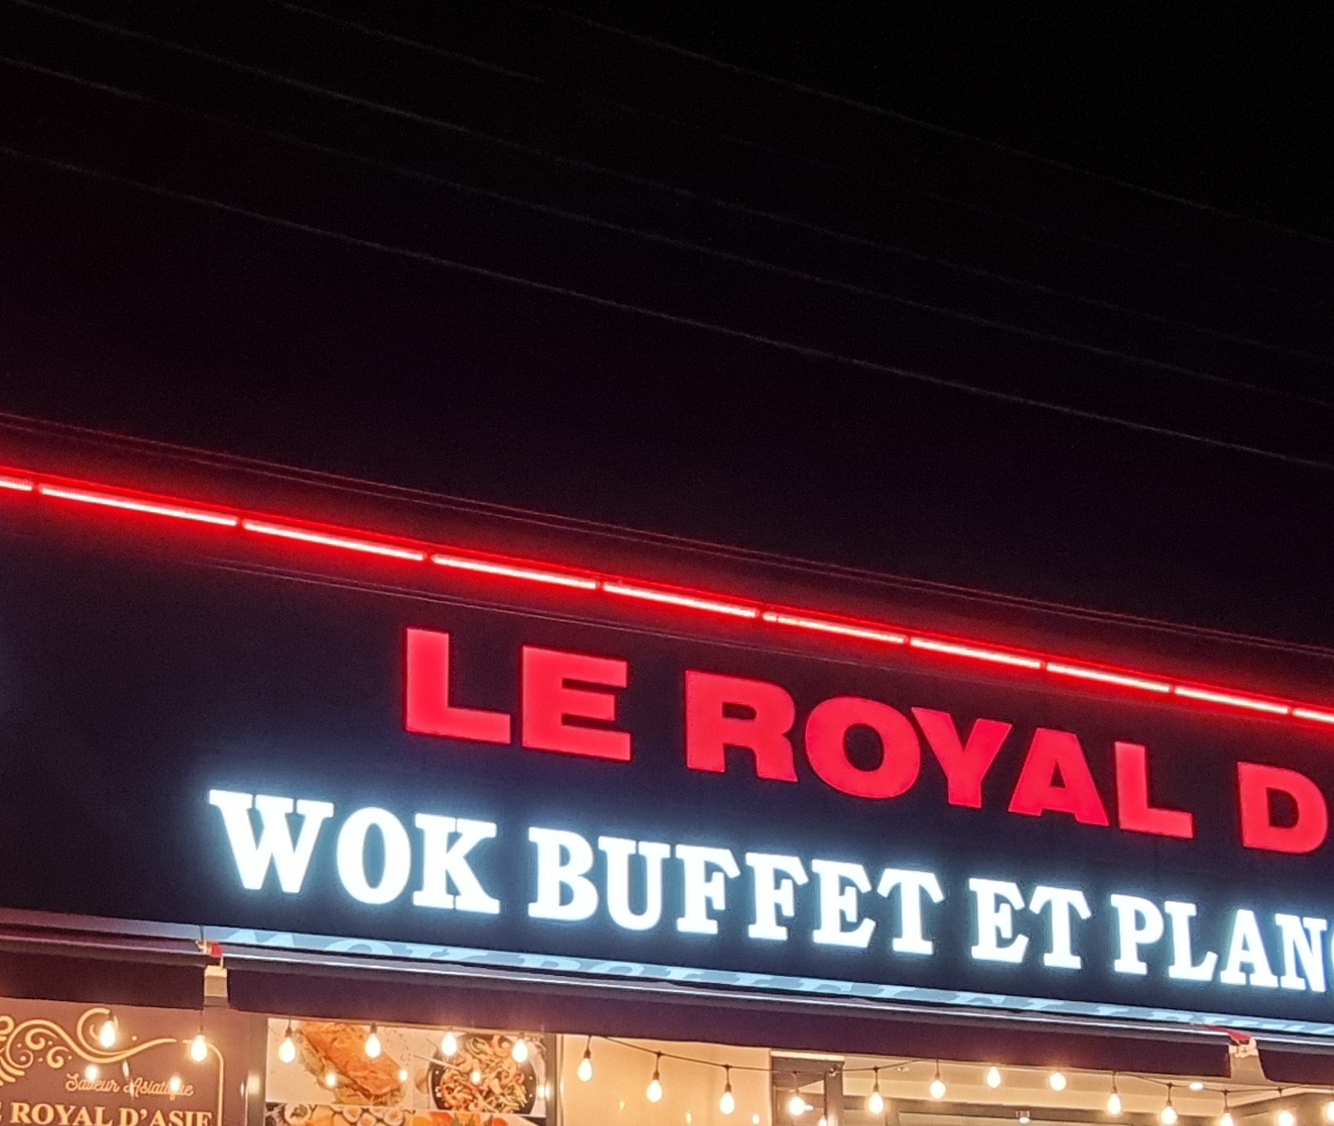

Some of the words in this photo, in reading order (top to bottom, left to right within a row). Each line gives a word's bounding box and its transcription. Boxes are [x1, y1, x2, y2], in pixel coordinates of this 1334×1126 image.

[405, 627, 633, 763] LE
[684, 669, 1194, 840] ROYAL
[208, 789, 500, 915] WOK
[527, 826, 945, 957] BUFFET
[968, 877, 1092, 970] ET
